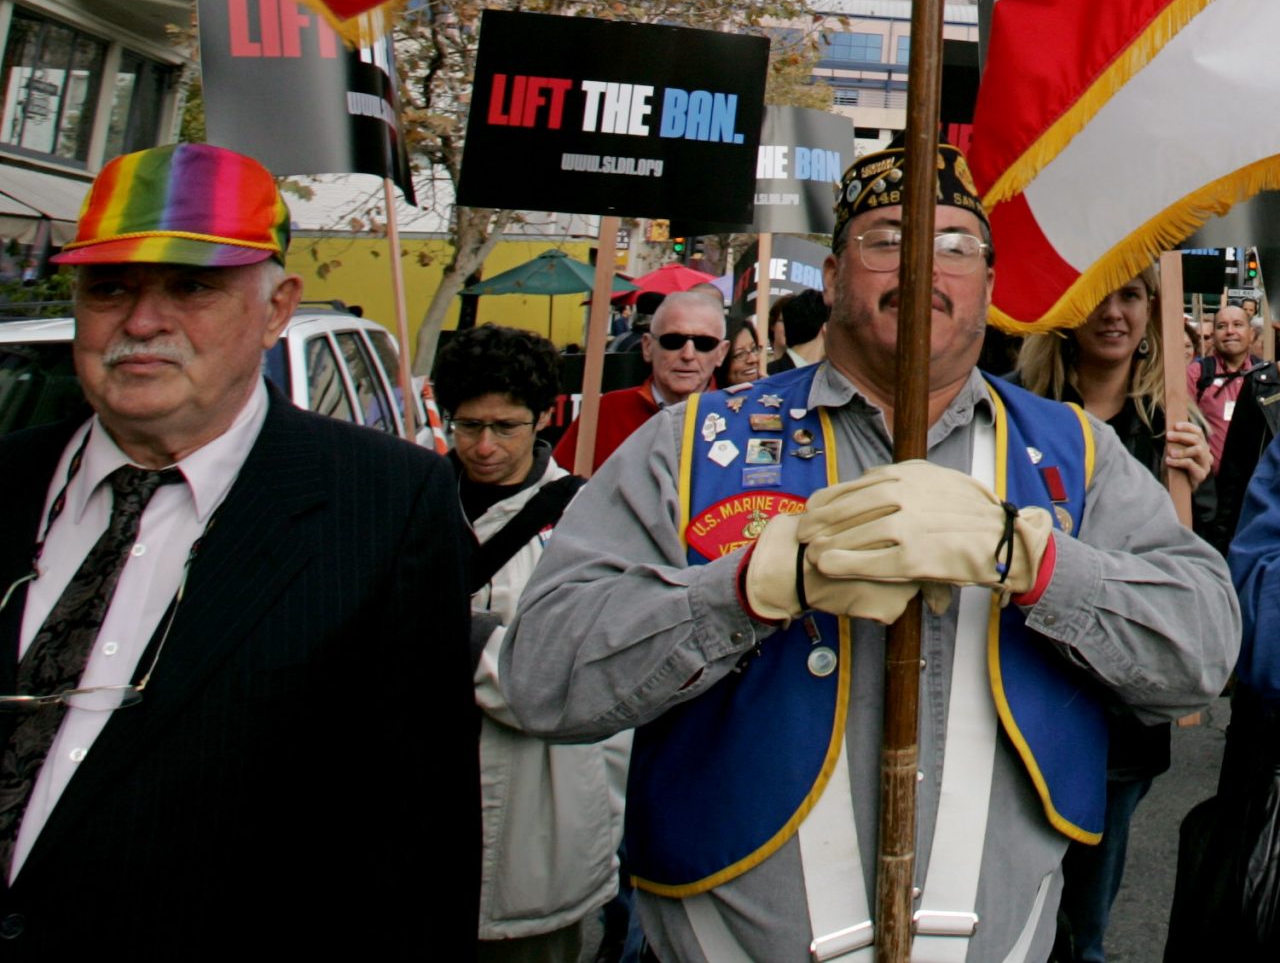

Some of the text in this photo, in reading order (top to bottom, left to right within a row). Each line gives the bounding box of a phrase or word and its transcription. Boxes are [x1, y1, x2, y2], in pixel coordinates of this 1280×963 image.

[487, 73, 744, 144] LIFT THE BAN.
[756, 145, 789, 179] HE
[867, 191, 900, 207] 448
[692, 514, 721, 536] U.S.
[720, 496, 774, 519] MARINE
